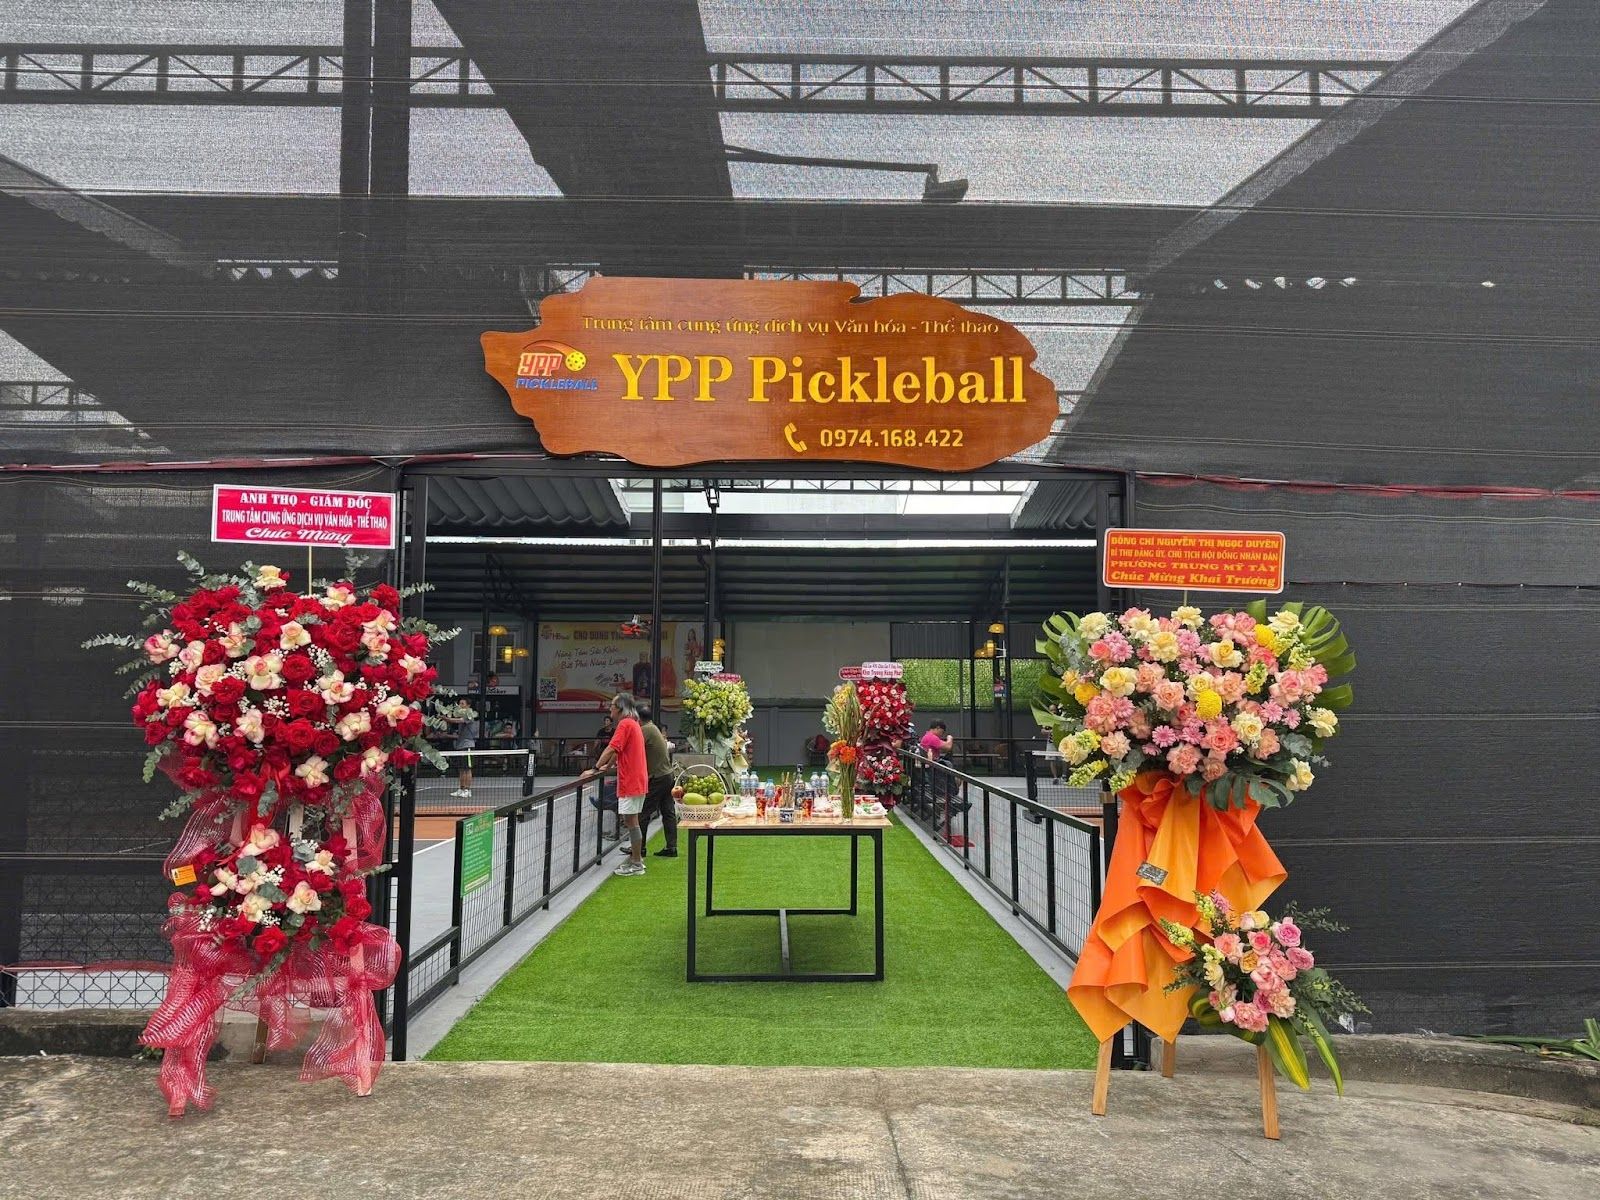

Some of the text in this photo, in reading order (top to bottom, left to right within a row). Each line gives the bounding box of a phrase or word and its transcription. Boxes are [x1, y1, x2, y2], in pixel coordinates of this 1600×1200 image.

[582, 315, 634, 333] Trung
[639, 316, 673, 331] tâm
[677, 318, 721, 334] cung
[726, 316, 760, 335] ứng
[764, 318, 803, 336] dịch
[807, 321, 830, 336] vụ
[834, 318, 869, 334] Văn
[874, 318, 907, 334] hóa
[921, 316, 956, 334] Thể
[961, 319, 1000, 334] thao
[517, 352, 563, 376] YPP
[516, 378, 598, 391] PICKLEBALL
[612, 354, 1027, 404] YPP Pickleball
[820, 428, 964, 448] 0974.168.422
[240, 492, 268, 504] ANH
[271, 494, 298, 507] THỌ
[310, 494, 344, 508] GIÁM
[347, 495, 372, 510] ĐỐC
[222, 509, 246, 524] TRUNG
[246, 506, 260, 524] TÂM
[261, 510, 280, 525] CUNG
[282, 508, 296, 525] ỨNG
[297, 512, 313, 528] DỊCH
[314, 513, 323, 530] VỤ
[324, 511, 338, 527] VĂN
[339, 511, 353, 528] HÓA
[357, 510, 369, 528] THỂ
[370, 516, 388, 529] THAO
[245, 527, 354, 544] Chúc Mừng
[1111, 534, 1137, 545] ĐỒNG
[1139, 536, 1154, 546] CHÍ
[1157, 536, 1196, 546] NGUYỄN
[1216, 539, 1243, 549] NGỌC
[1110, 560, 1278, 572] PHƯỜNG TRUNG MỸ TÂY
[1111, 571, 1276, 587] Chúc Mừng Khai Trương
